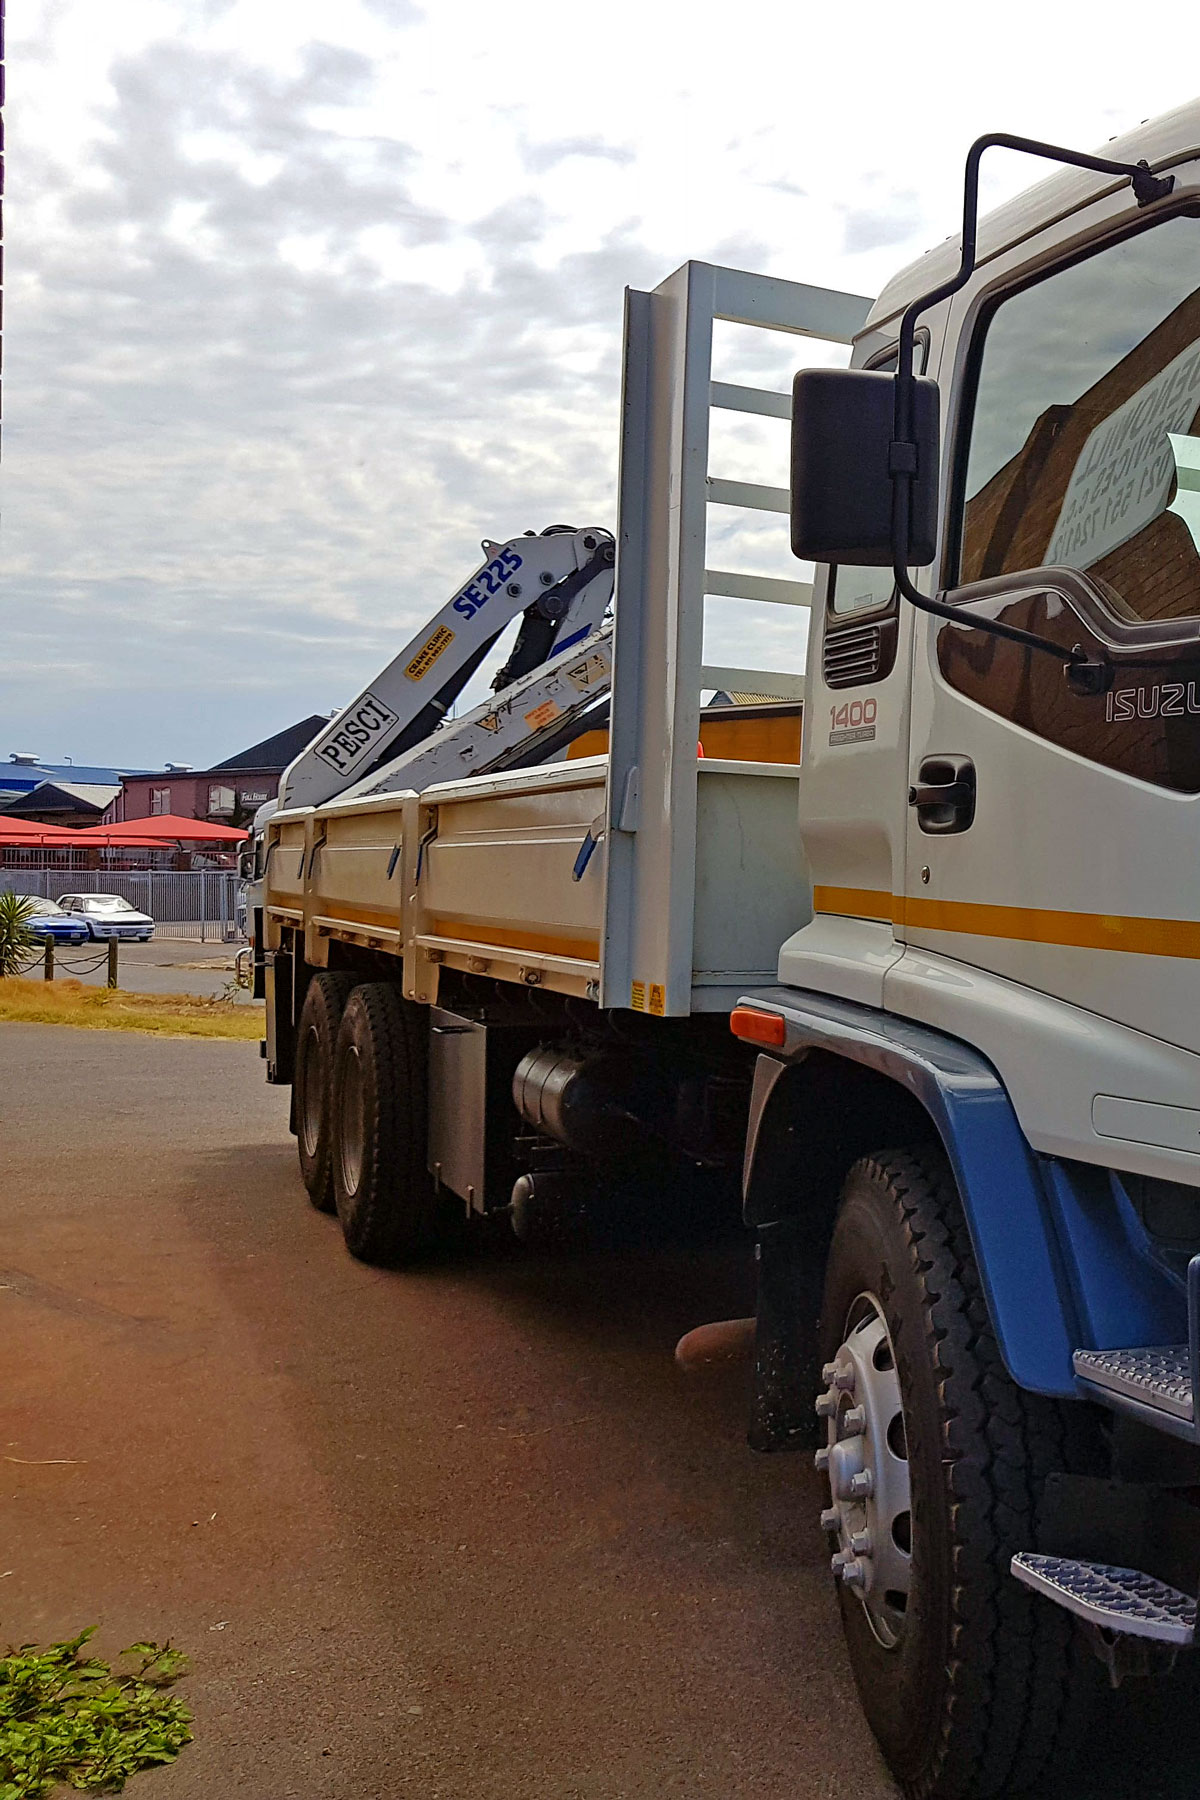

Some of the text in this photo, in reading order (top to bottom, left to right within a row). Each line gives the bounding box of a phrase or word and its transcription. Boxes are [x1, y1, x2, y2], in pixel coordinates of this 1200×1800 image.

[408, 628, 447, 673] CRANE CLINIC
[321, 700, 391, 769] PESCI
[830, 698, 877, 730] 1400
